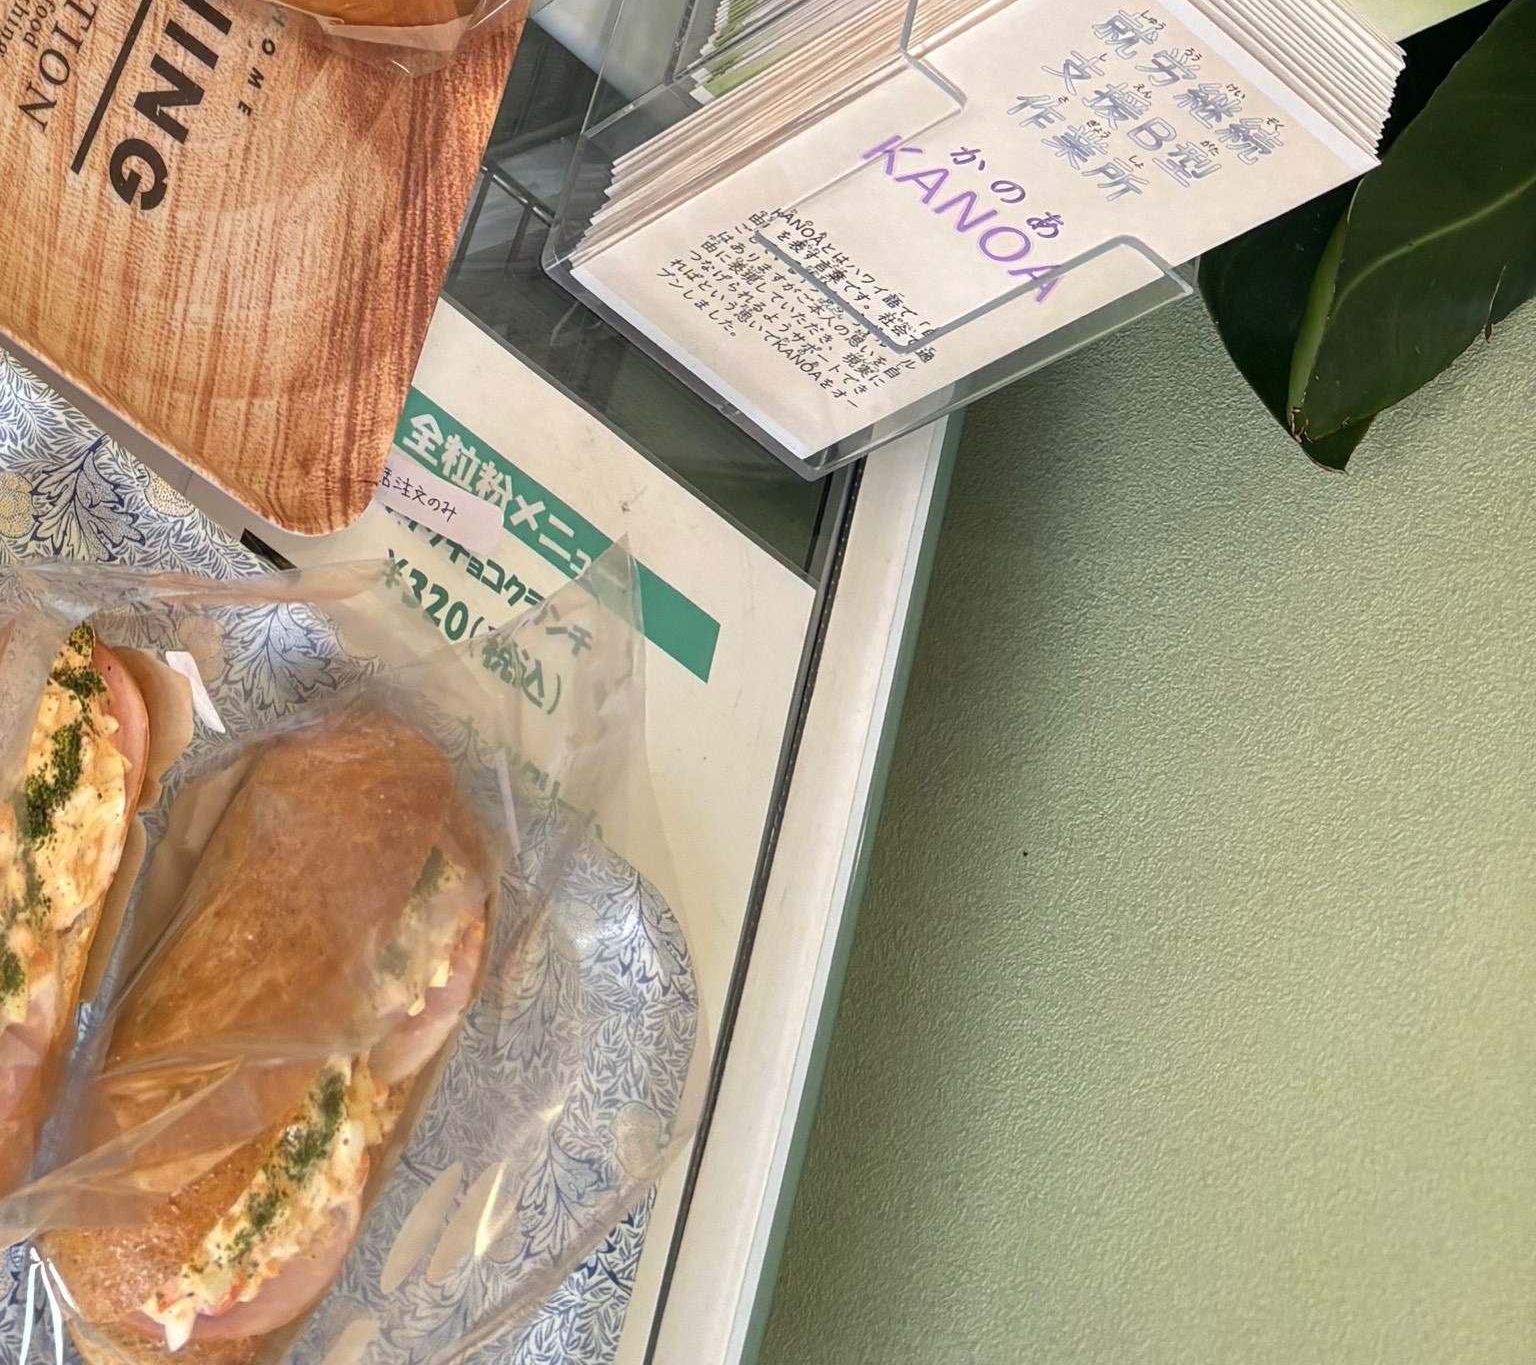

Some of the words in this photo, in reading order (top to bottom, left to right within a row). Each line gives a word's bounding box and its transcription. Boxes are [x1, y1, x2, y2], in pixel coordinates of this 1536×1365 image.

[1006, 93, 1151, 202] 作業所
[1041, 50, 1223, 188] 支援B型
[1091, 8, 1284, 166] 就労継続
[860, 133, 1063, 303] KANOA
[949, 146, 1064, 239] かのあ
[689, 250, 869, 395] つなげられるようサポートでき
